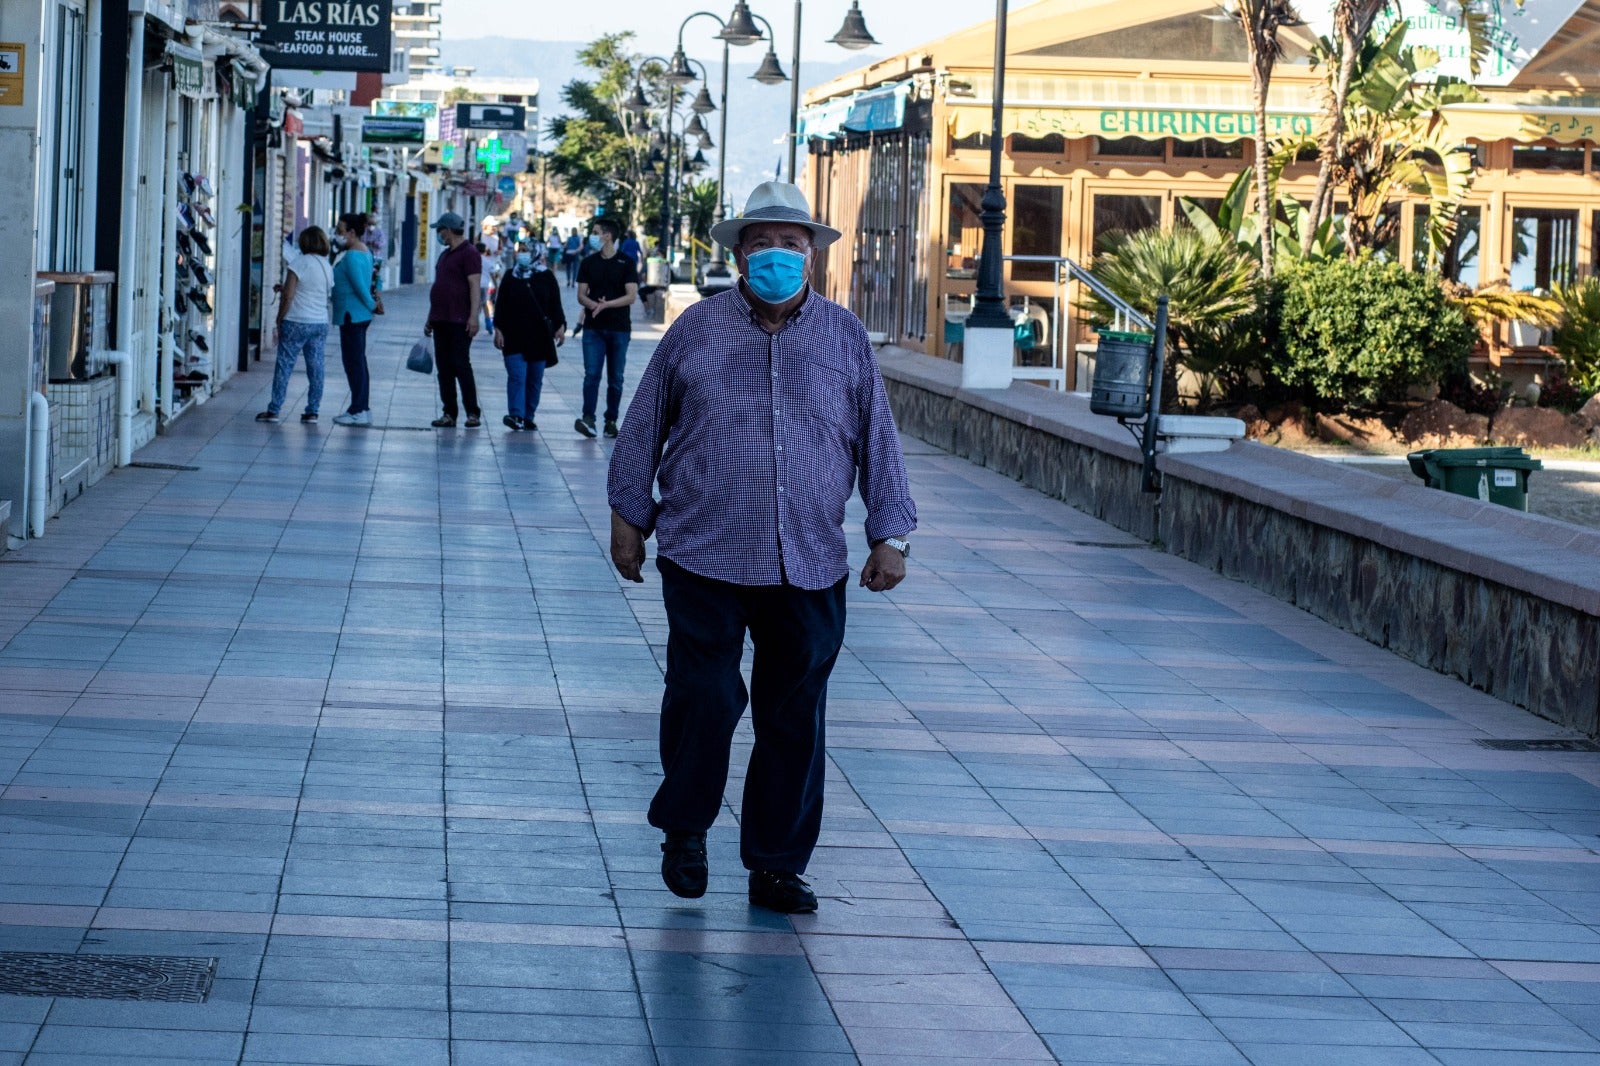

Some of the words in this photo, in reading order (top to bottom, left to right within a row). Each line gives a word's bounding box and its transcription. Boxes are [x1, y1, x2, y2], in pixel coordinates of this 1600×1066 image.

[278, 0, 322, 24] LAS
[326, 0, 380, 26] RÍAS
[294, 30, 326, 42] STEAK
[328, 31, 363, 44] HOUSE
[326, 44, 335, 55] &
[338, 45, 378, 57] MORE...
[1100, 111, 1312, 136] CHIRINGUTO
